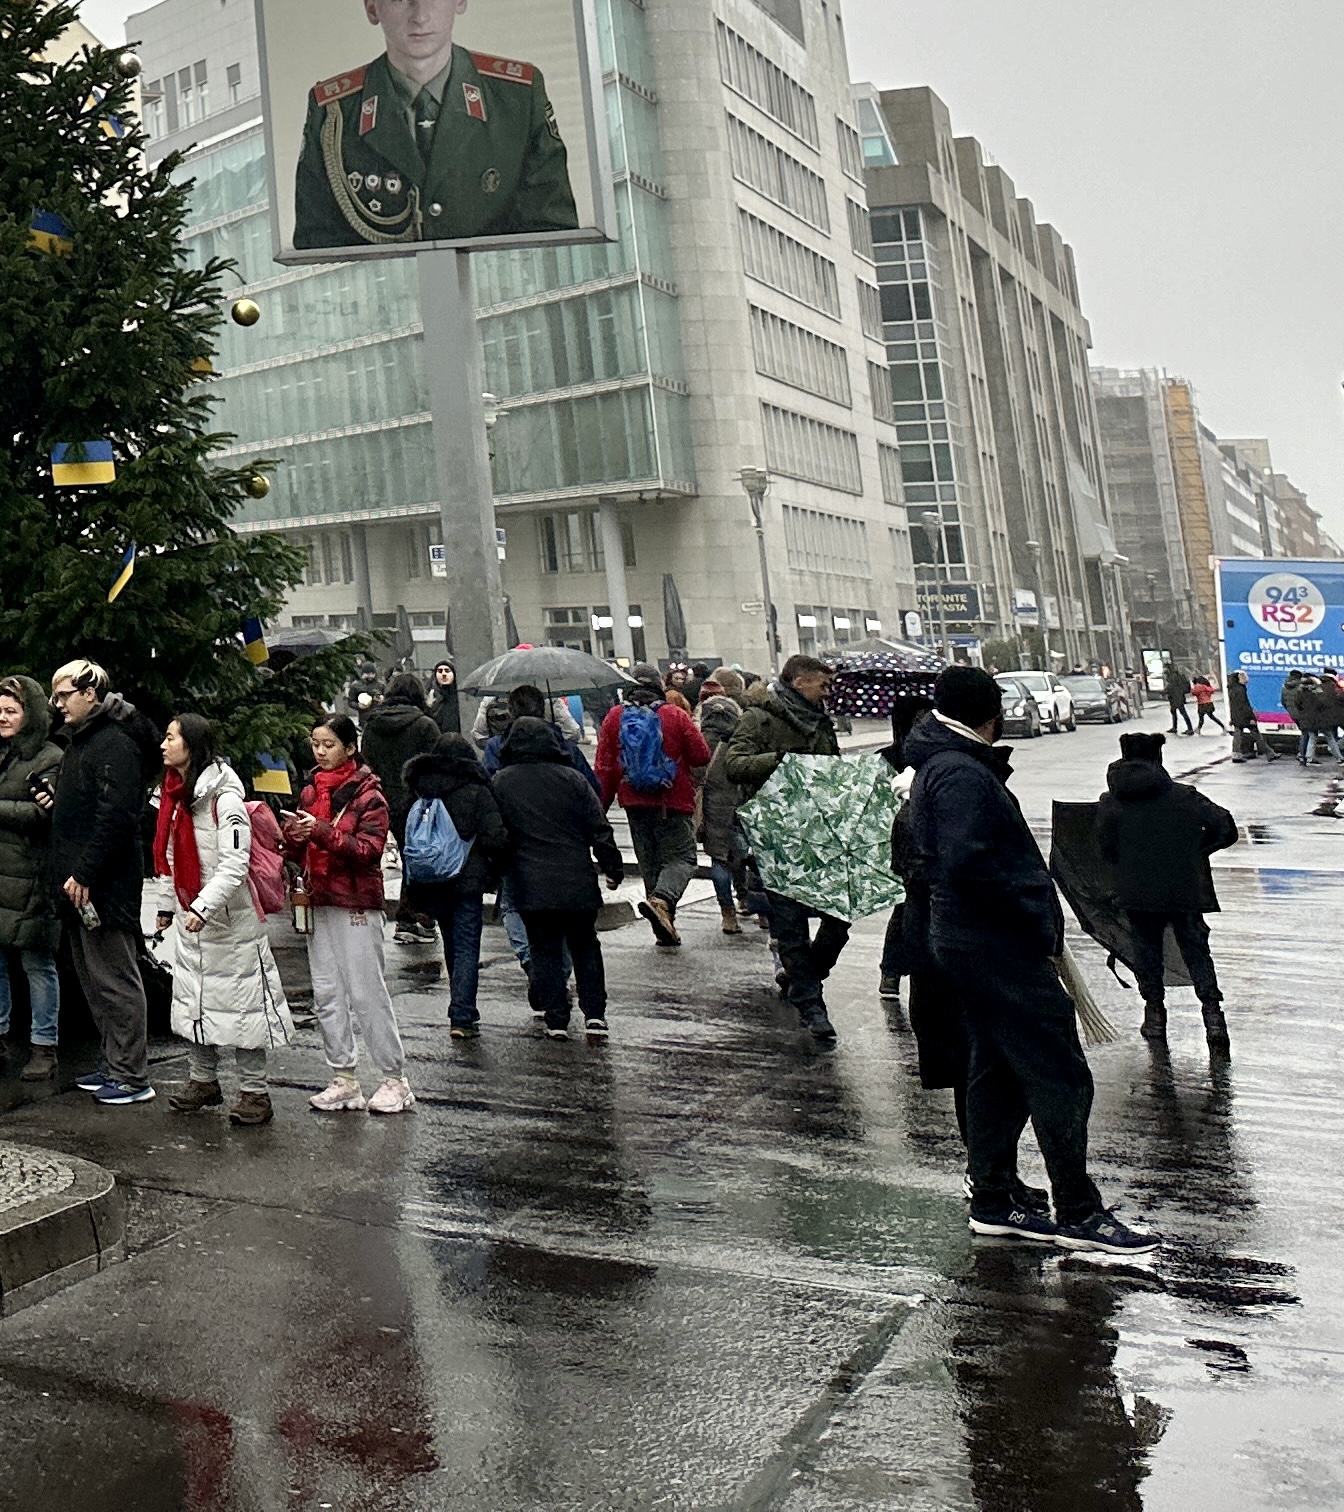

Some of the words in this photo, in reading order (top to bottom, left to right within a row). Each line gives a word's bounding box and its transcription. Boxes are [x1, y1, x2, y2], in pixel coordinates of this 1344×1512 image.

[1261, 604, 1314, 623] RS2
[1258, 638, 1324, 652] MACHT
[1238, 649, 1344, 667] GLÜCKLICH!
